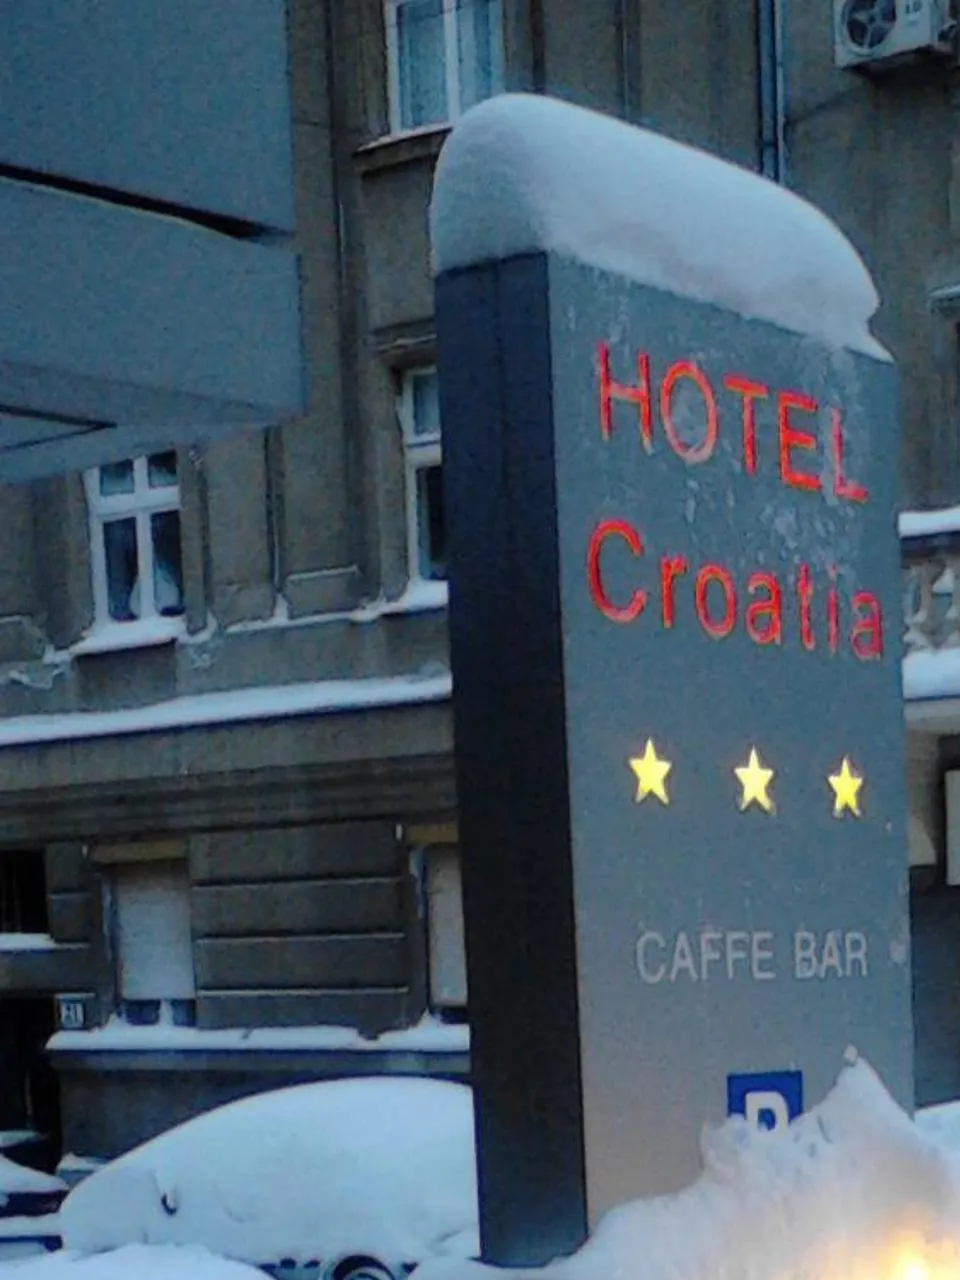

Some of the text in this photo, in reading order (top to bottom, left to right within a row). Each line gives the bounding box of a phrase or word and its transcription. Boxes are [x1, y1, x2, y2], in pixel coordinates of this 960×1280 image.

[596, 340, 868, 502] HOTEL
[587, 519, 884, 661] Croatia
[636, 930, 868, 984] CAFFE BAR
